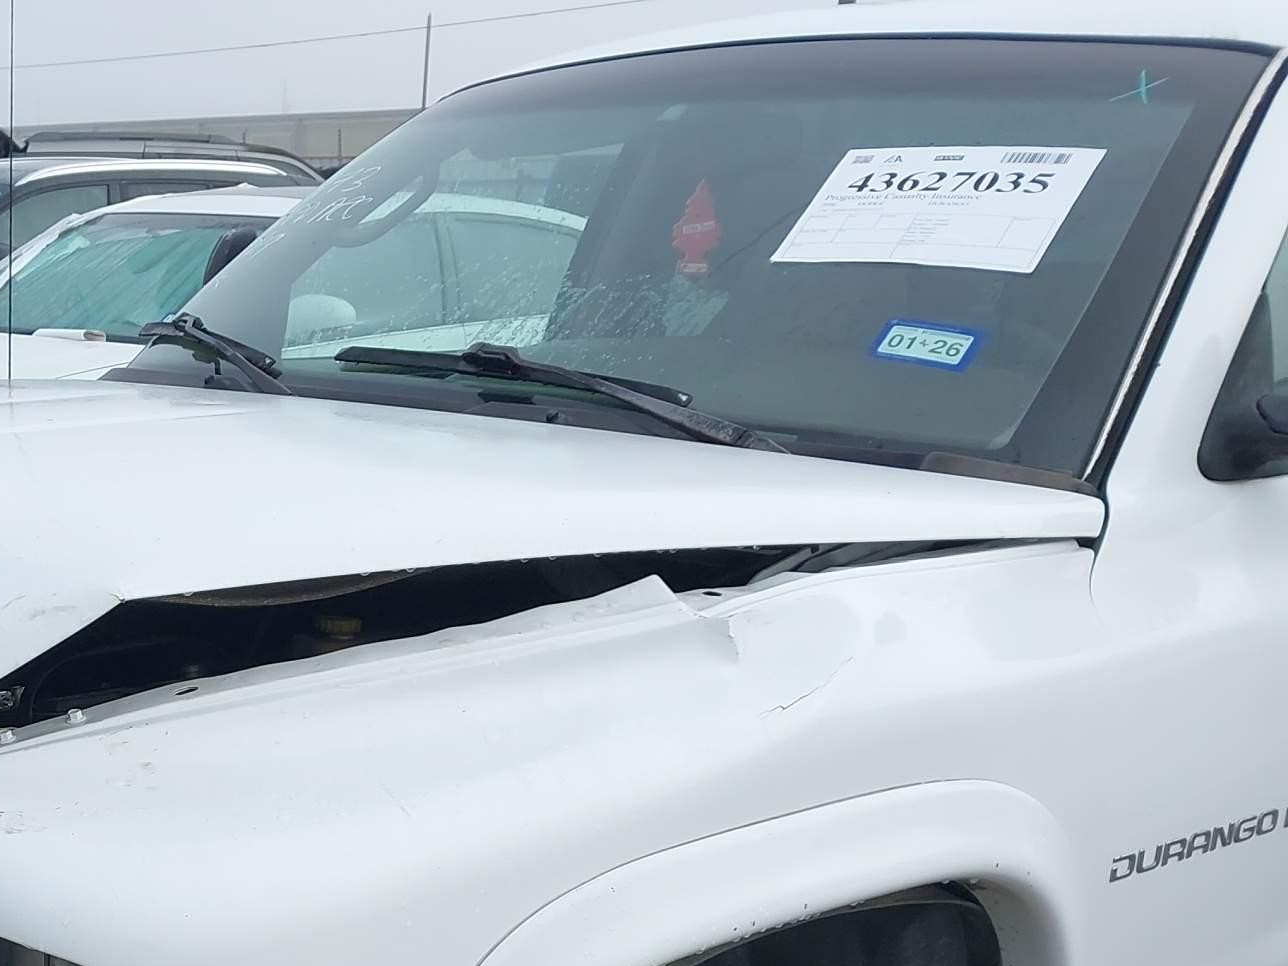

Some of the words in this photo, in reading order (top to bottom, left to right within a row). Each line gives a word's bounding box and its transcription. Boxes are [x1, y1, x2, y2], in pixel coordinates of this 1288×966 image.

[847, 171, 1056, 194] 43627035
[824, 193, 882, 202] Progressive
[884, 192, 929, 201] Casualty
[932, 192, 984, 200] Insurance
[887, 333, 918, 350] 01
[928, 339, 964, 357] 26
[1109, 808, 1279, 883] DURANGO
